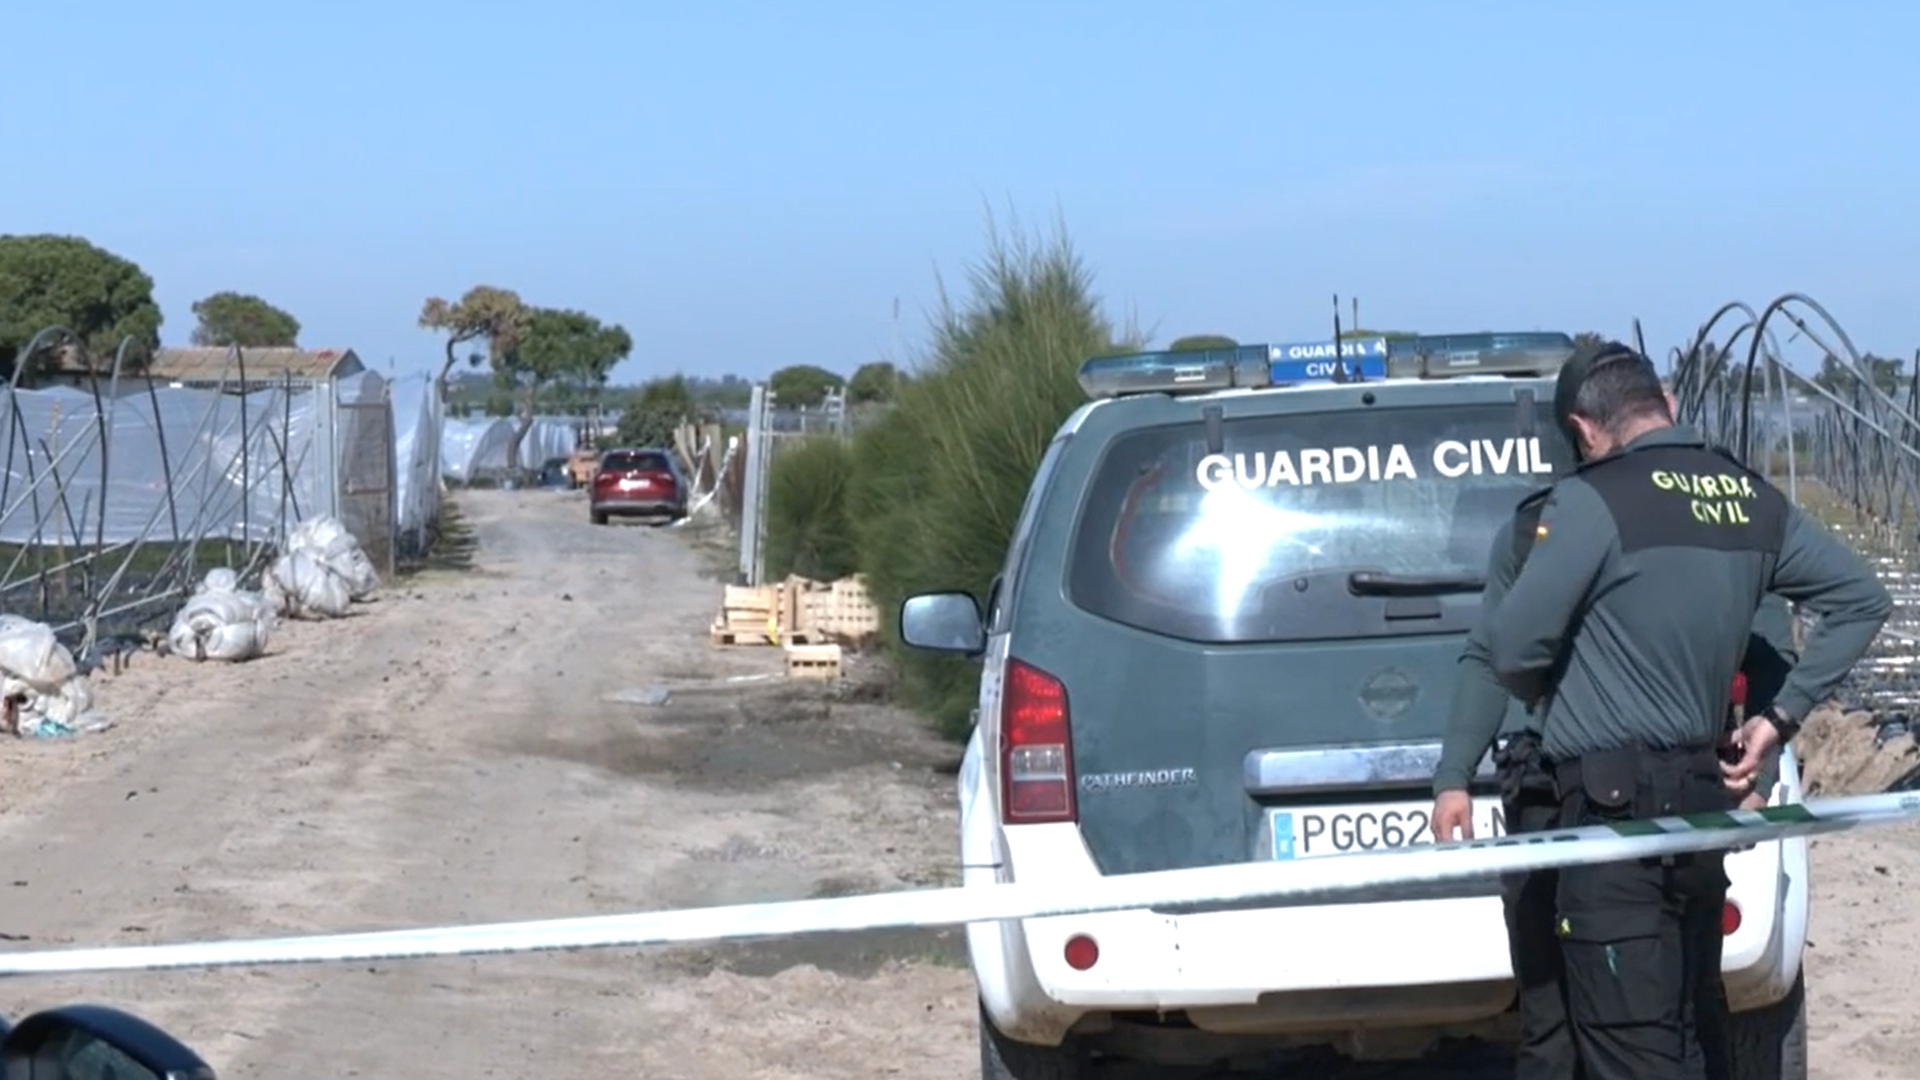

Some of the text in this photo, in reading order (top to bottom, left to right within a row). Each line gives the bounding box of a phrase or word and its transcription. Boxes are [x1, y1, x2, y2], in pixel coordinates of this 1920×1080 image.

[1306, 362, 1350, 376] CIVL
[1196, 437, 1552, 490] GUARDIA CIVIL
[1651, 470, 1757, 498] GUARDIA
[1690, 499, 1750, 524] CIVIL
[1082, 767, 1196, 791] PATHFINDER
